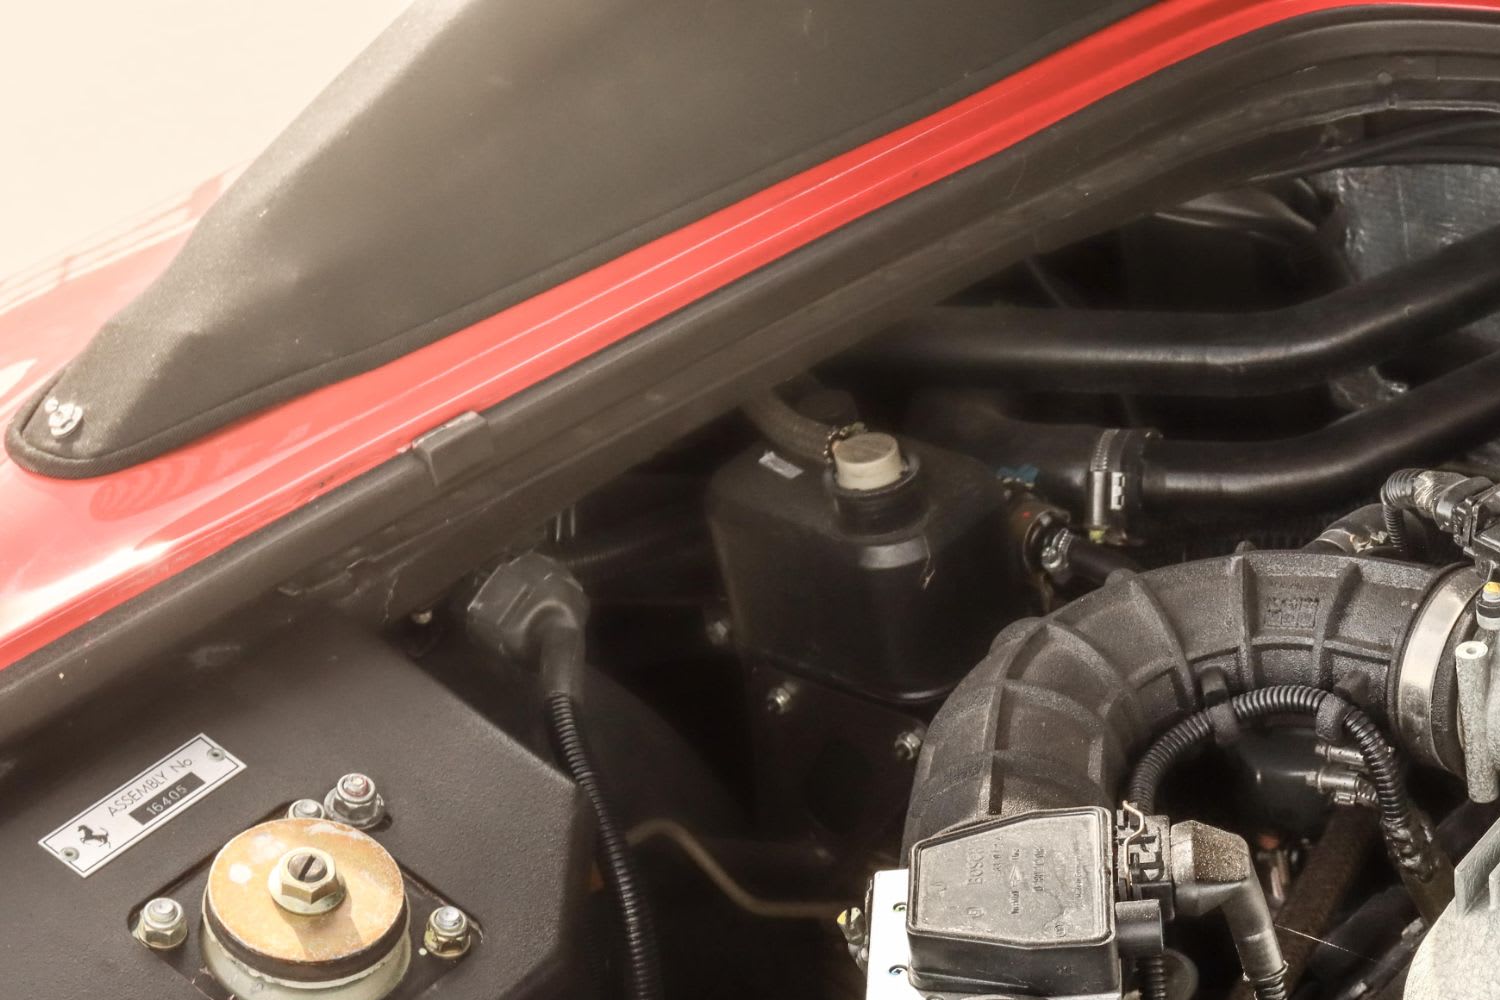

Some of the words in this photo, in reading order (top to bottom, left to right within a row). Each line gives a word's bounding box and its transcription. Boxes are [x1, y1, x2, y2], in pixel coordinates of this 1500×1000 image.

[107, 770, 168, 817] ASSEMBLY
[170, 757, 193, 774] No
[146, 785, 188, 816] 16405
